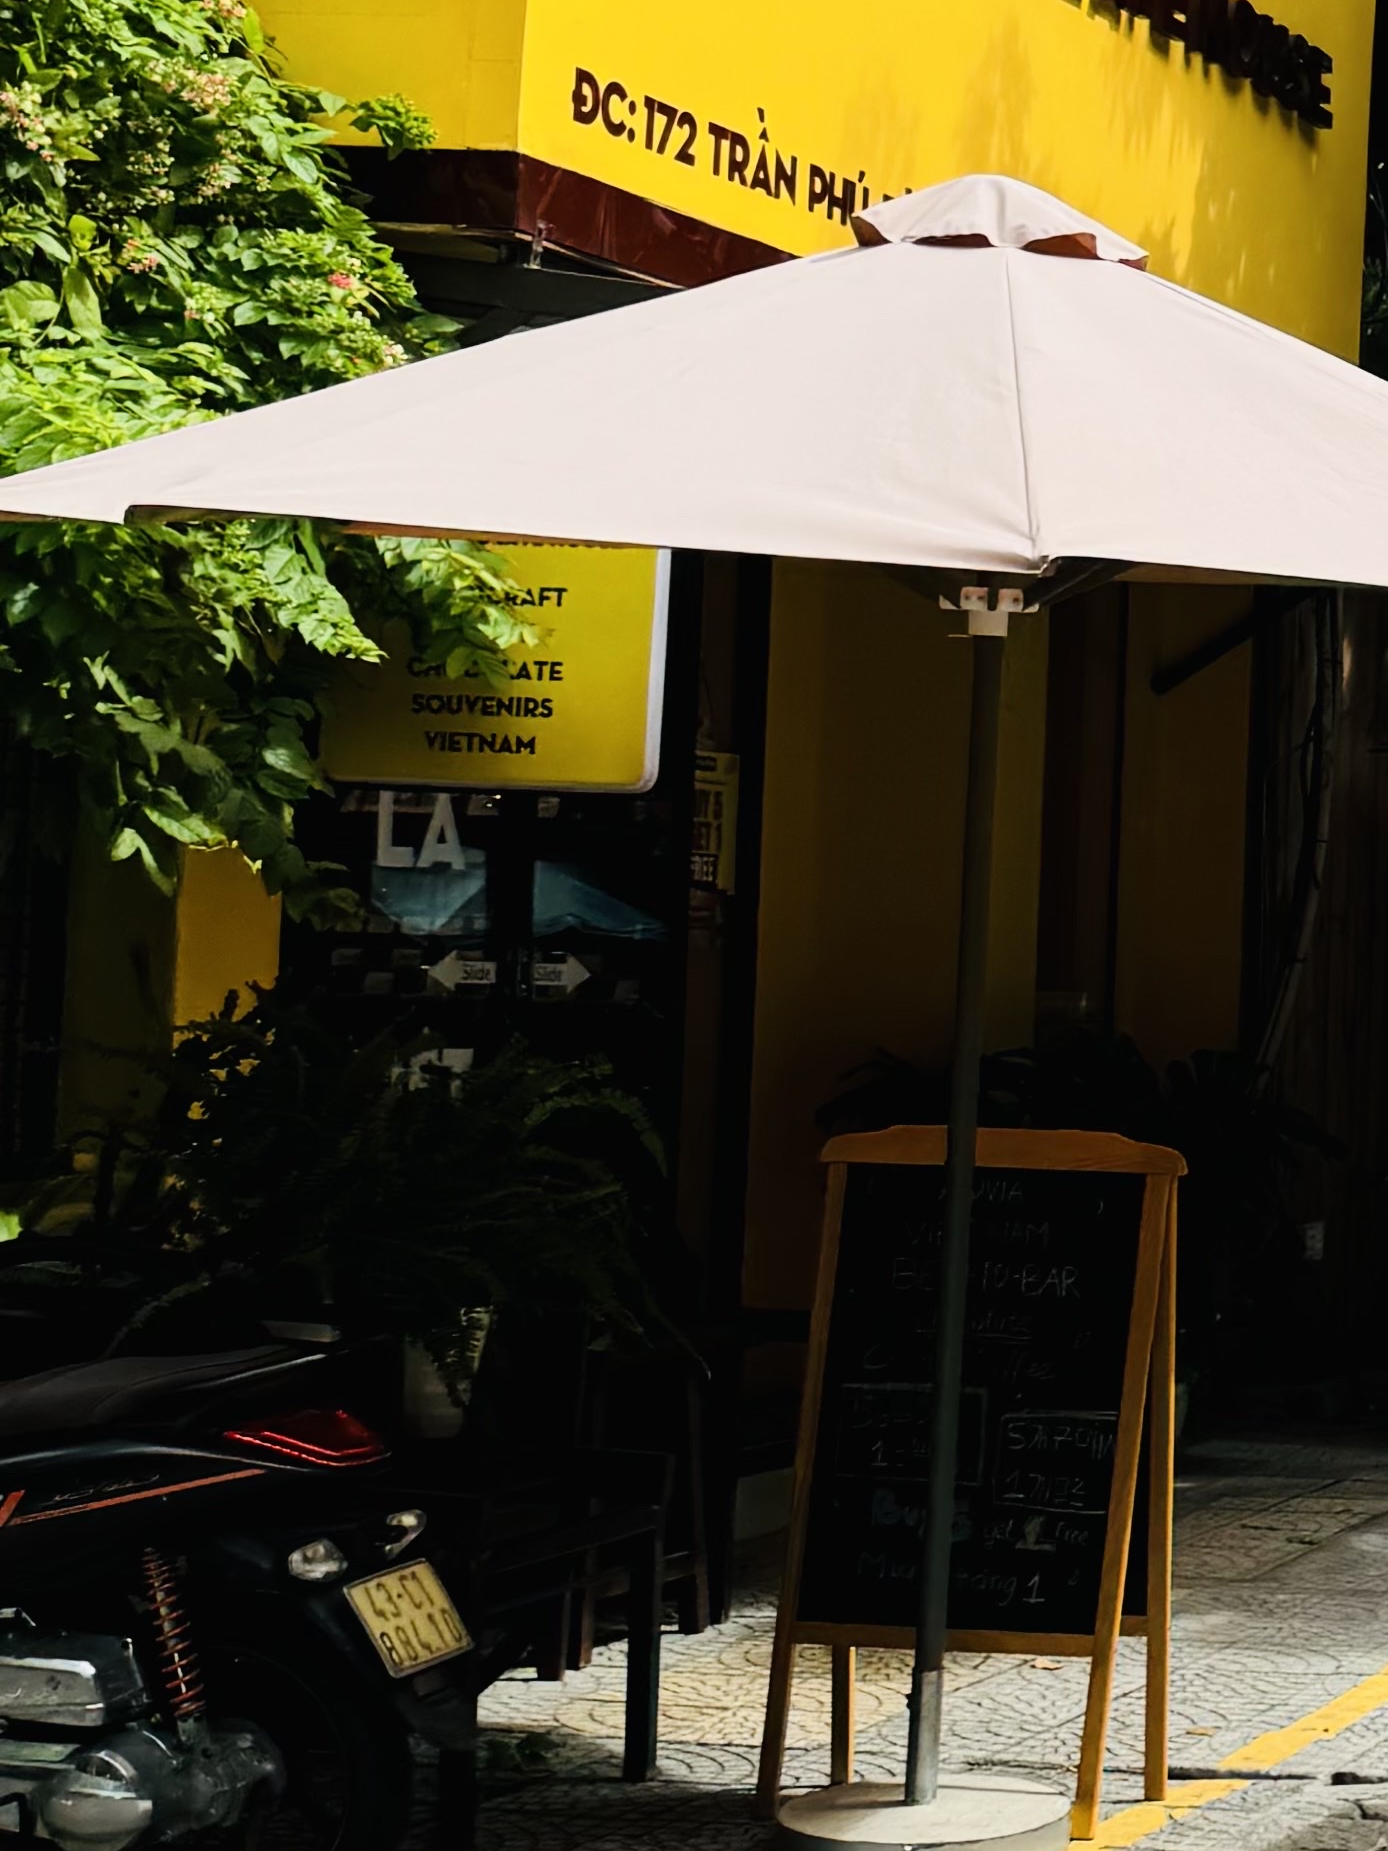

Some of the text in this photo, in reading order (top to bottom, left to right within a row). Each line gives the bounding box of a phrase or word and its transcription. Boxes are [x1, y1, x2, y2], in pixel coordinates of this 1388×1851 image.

[644, 95, 698, 166] 172
[708, 107, 798, 206] TRẦN
[411, 693, 553, 718] SOUVENIRS
[424, 731, 536, 755] VIETNAM
